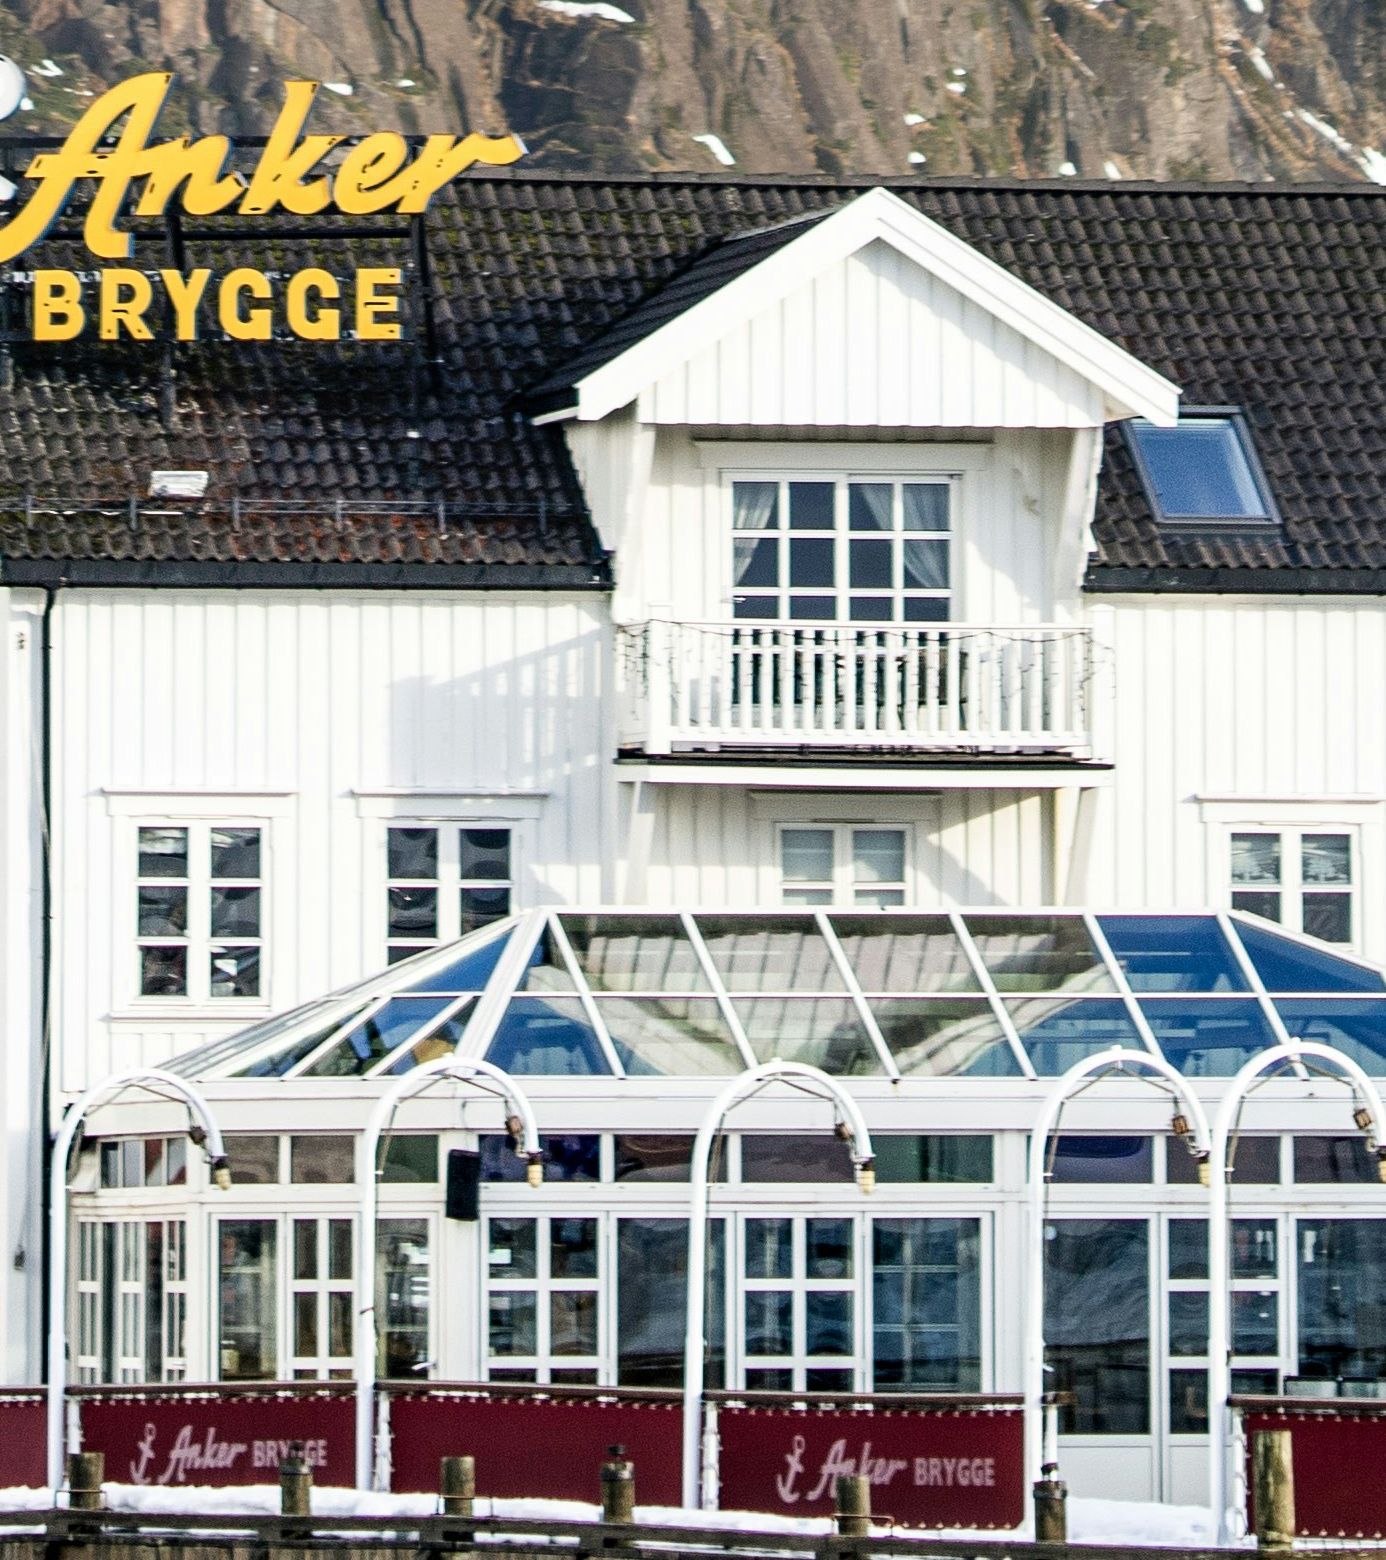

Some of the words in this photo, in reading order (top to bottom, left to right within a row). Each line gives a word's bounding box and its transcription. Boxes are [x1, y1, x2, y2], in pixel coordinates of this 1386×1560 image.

[33, 268, 403, 342] BRYGGE
[157, 1425, 247, 1483] Anker
[253, 1439, 328, 1467] BRYGE
[915, 1458, 995, 1486] BRYGGE
